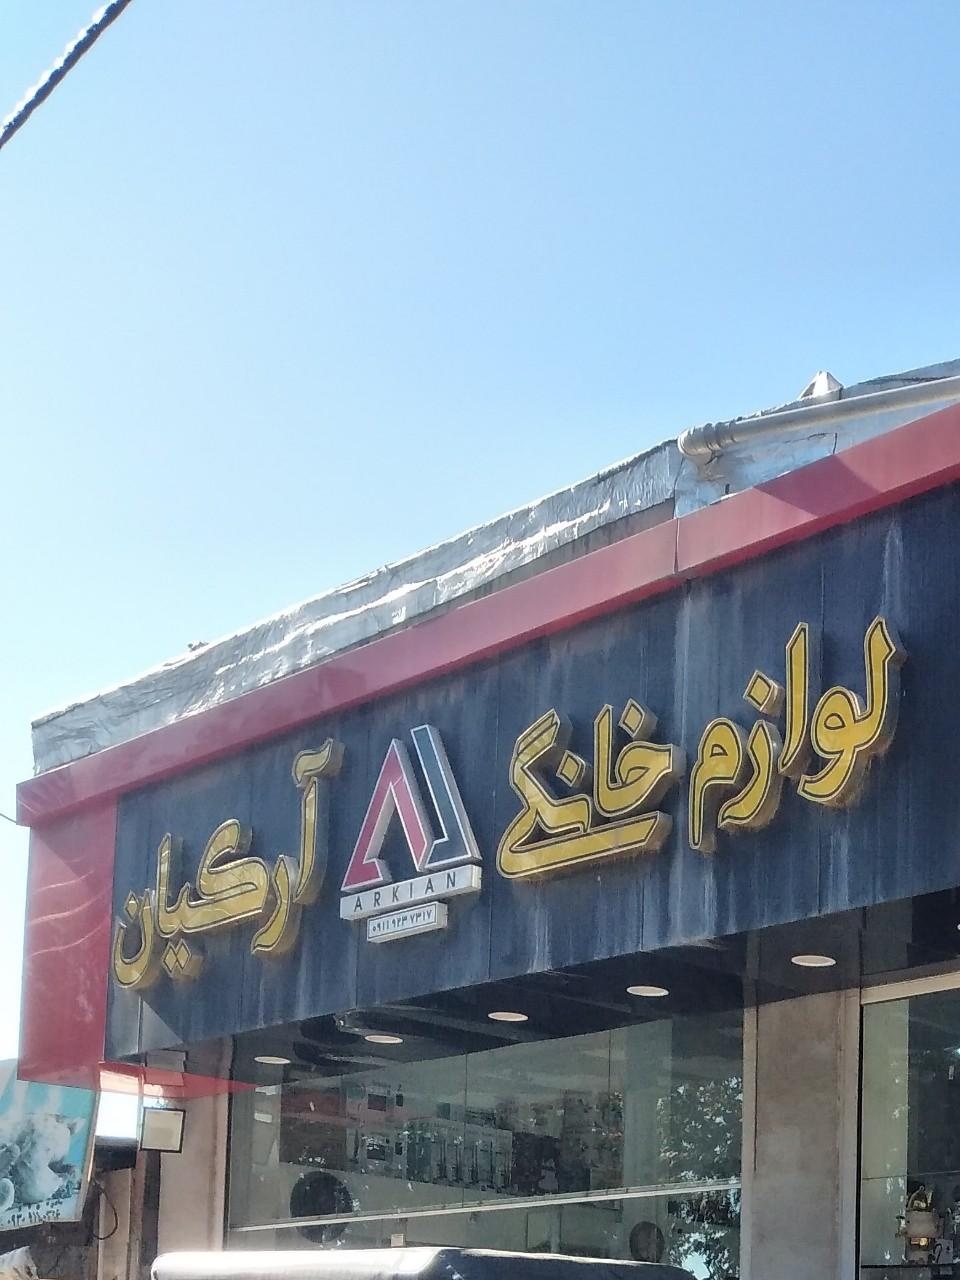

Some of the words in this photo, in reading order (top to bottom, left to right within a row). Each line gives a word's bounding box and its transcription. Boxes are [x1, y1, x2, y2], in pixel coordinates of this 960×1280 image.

[495, 697, 674, 879] خانگی
[688, 615, 897, 850] لوازم
[111, 737, 335, 989] آرکیان
[353, 871, 456, 913] ARKIAN
